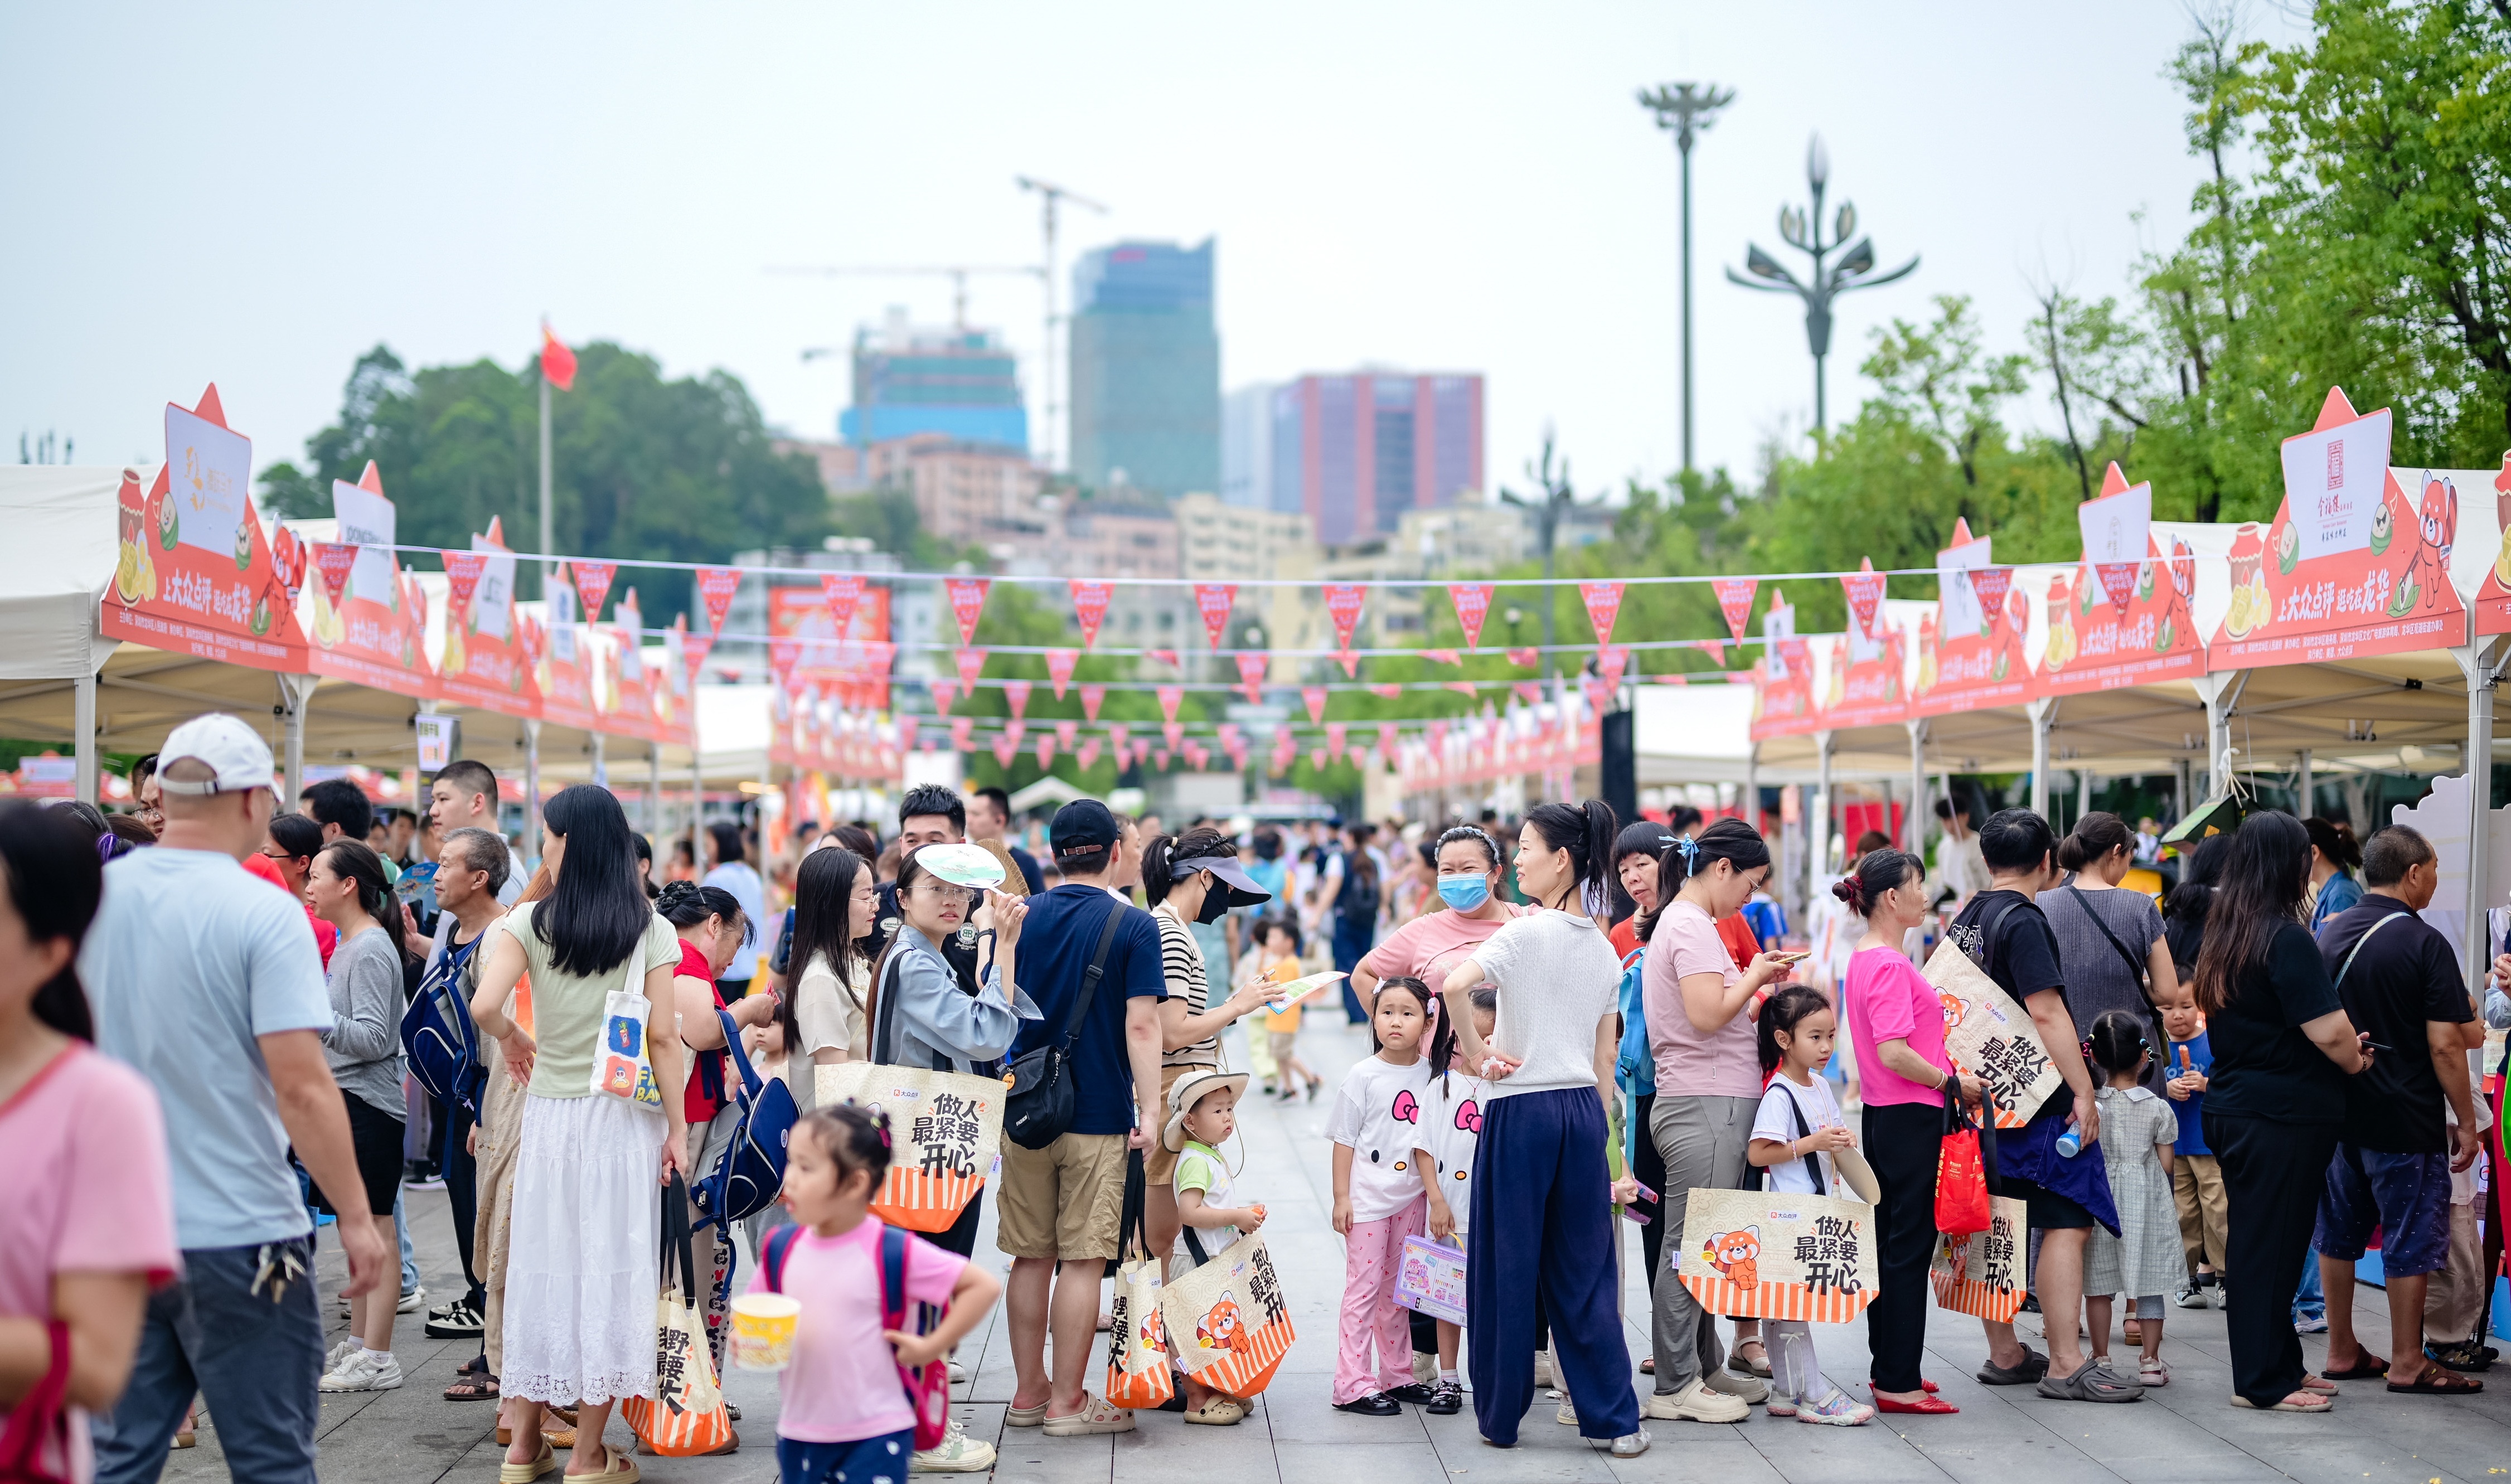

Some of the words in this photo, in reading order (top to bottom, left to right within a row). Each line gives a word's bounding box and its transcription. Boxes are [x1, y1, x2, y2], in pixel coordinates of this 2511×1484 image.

[163, 567, 212, 617] 上大众点评
[2277, 581, 2335, 623] 上大众点评
[2336, 568, 2390, 614] 逛吃在龙华
[1990, 1007, 2006, 1022] 大众点评
[1979, 1036, 2038, 1090] 最紧要
[2010, 1035, 2049, 1075] 做人
[901, 1090, 918, 1098] 大众点评
[1974, 1062, 2022, 1111] 开心
[933, 1093, 980, 1122] 做人
[912, 1117, 979, 1146] 最紧要
[920, 1143, 976, 1179] 开心
[1815, 1215, 1859, 1241] 做人
[1992, 1216, 2013, 1240] 做人
[1794, 1236, 1859, 1264] 最紧要
[1984, 1236, 2014, 1262] 最紧要
[1805, 1262, 1862, 1296] 开心
[1985, 1262, 2014, 1296] 开心
